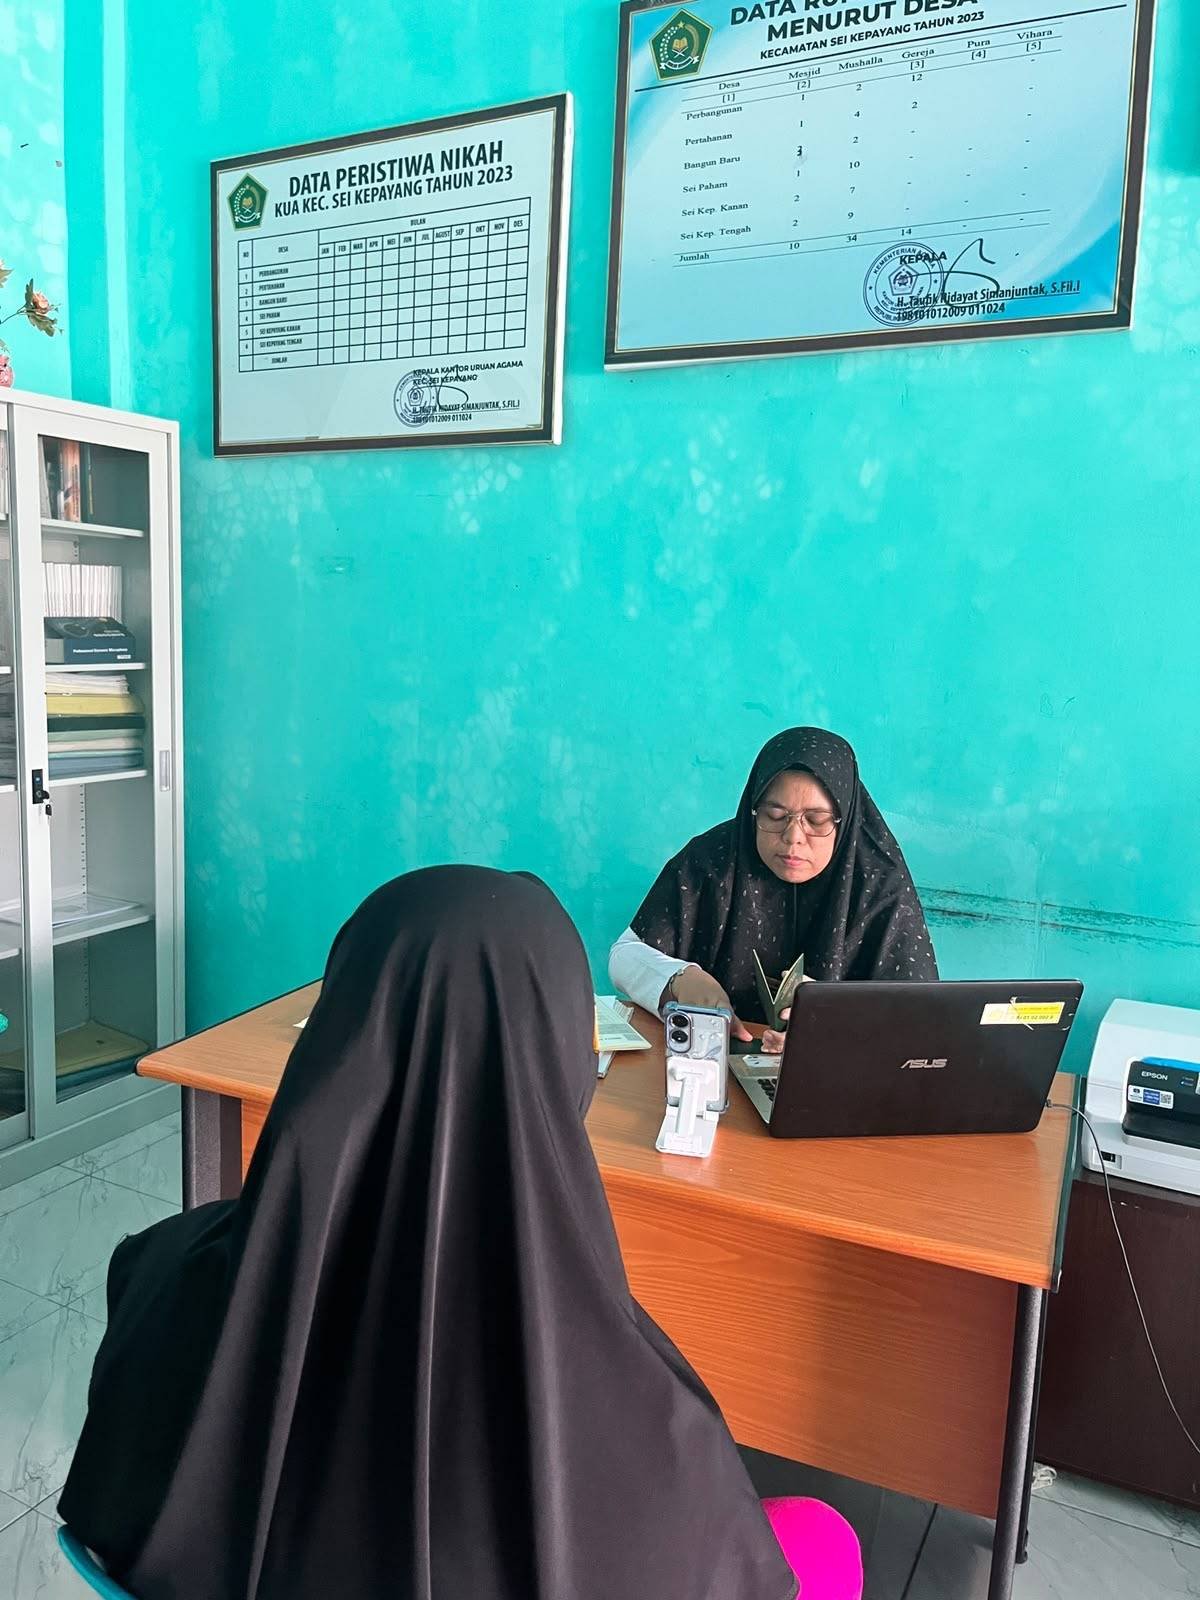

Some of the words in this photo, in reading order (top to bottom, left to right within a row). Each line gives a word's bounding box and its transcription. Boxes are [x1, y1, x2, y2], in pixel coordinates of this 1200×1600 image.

[731, 0, 796, 25] DATA
[767, 2, 897, 41] MENURUT
[760, 40, 827, 60] KECAMATAN
[830, 35, 847, 47] SEI
[850, 23, 911, 43] KEPAYANG
[914, 16, 954, 31] TAHUN
[957, 11, 984, 24] 2023
[718, 81, 741, 91] Desa
[788, 67, 821, 80] Mesjid
[838, 57, 883, 71] Mushalla
[901, 48, 935, 60] Gereja
[966, 39, 991, 49] Pura
[1017, 29, 1053, 40] Vihara
[686, 104, 743, 121] Perbangunan
[856, 83, 862, 92] 2
[911, 73, 923, 82] 12
[685, 132, 733, 146] Pertahanan
[853, 110, 861, 119] 4
[911, 101, 918, 109] 2
[289, 170, 331, 197] DATA
[336, 152, 435, 187] PERISTIWA
[441, 140, 503, 172] NIKAH
[683, 159, 717, 172] Bangun
[719, 155, 741, 166] Baru
[852, 136, 859, 144] 2
[274, 201, 300, 218] KUA
[303, 197, 330, 214] KEC.
[332, 192, 352, 209] SEI
[355, 183, 423, 206] KEPAYANG
[425, 171, 473, 194] TAHUN
[477, 165, 514, 186] 2023
[682, 185, 696, 194] Sei
[698, 180, 728, 191] Paham
[848, 161, 861, 169] 10
[681, 208, 695, 217] Sei
[719, 202, 749, 212] Kanan
[849, 186, 855, 194] 7
[435, 230, 451, 239] AGUST
[455, 228, 465, 236] SEP
[475, 225, 486, 233] OKT
[494, 222, 505, 230] NOV
[513, 219, 524, 228] DES
[680, 232, 694, 240] Sei
[719, 225, 752, 236] Tengah
[792, 219, 799, 227] 2
[679, 252, 710, 262] Jumlah
[788, 242, 800, 250] 10
[901, 228, 912, 236] 14
[900, 250, 947, 265] KEPALA
[941, 288, 978, 304] Hidayat
[969, 302, 1006, 316] 011024
[470, 363, 496, 371] URUAN
[496, 360, 524, 369] AGAMA
[452, 414, 472, 422] 011024
[900, 1058, 947, 1069] ASUS
[1141, 1070, 1168, 1082] EPSON
